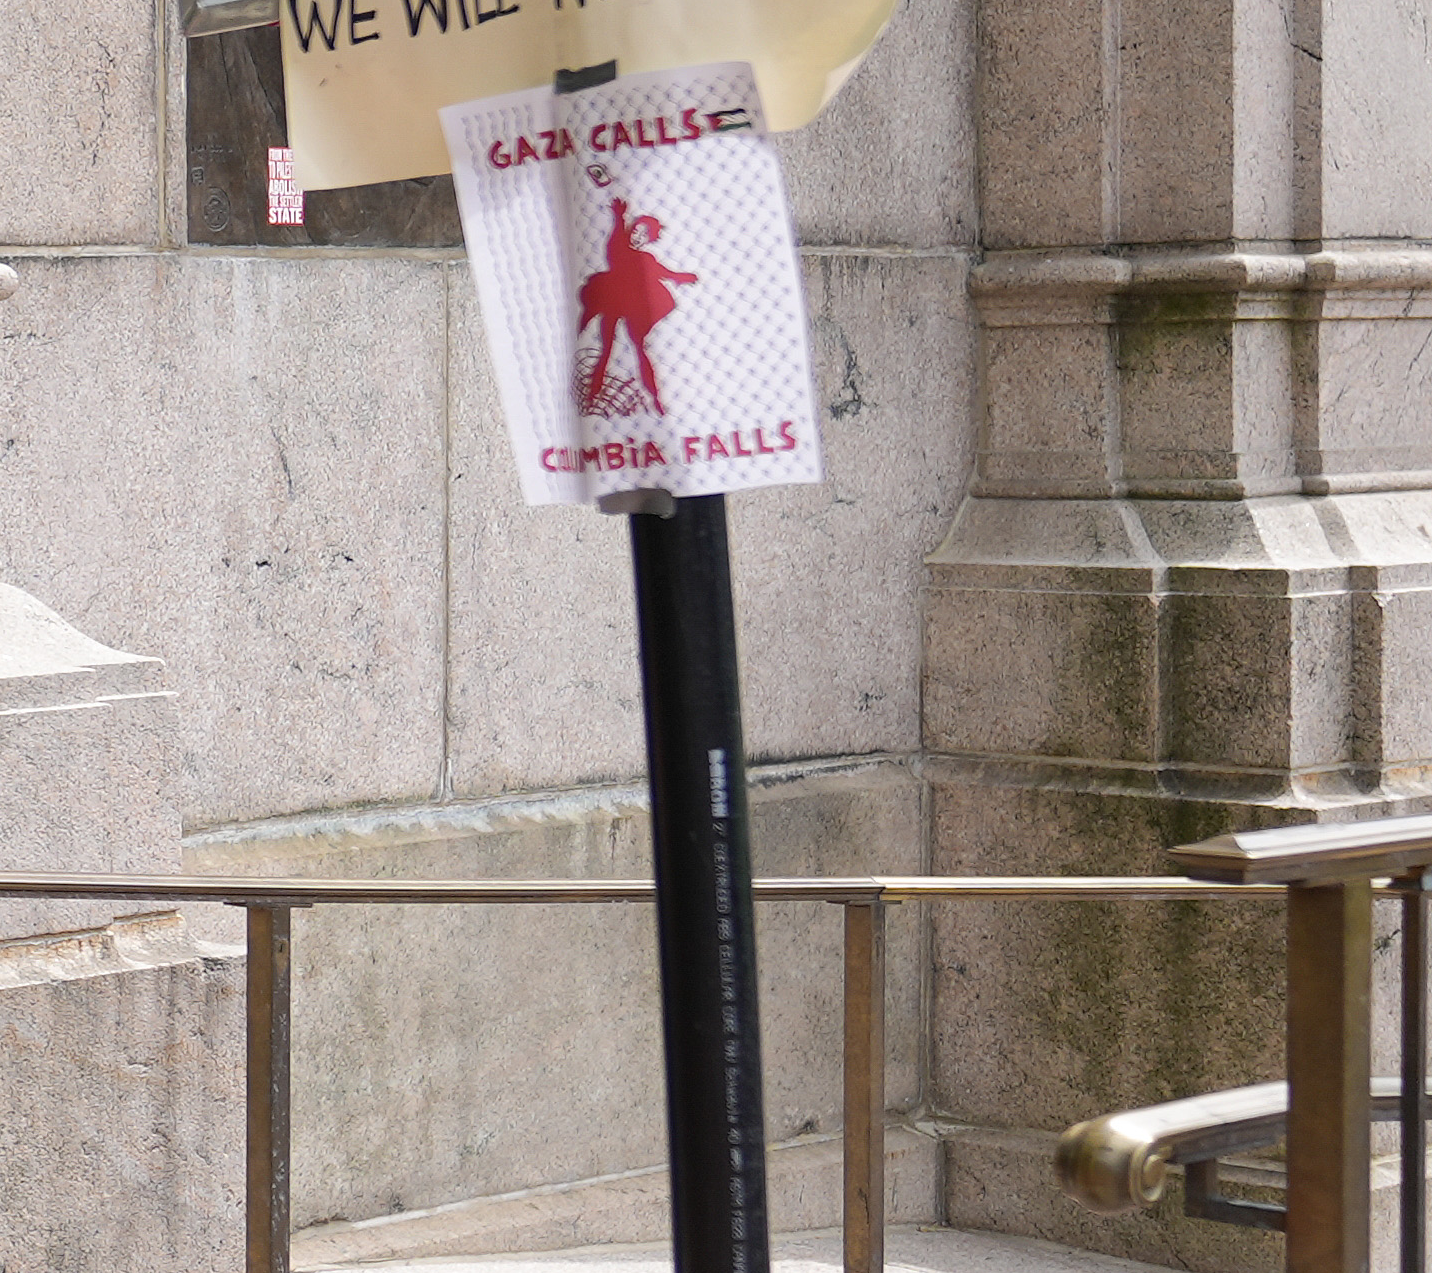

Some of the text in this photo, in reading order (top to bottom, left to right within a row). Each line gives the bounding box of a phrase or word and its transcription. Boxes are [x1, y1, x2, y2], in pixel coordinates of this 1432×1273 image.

[488, 108, 701, 170] GAZA CALLS
[269, 208, 303, 224] STATE
[683, 421, 798, 464] FALLS
